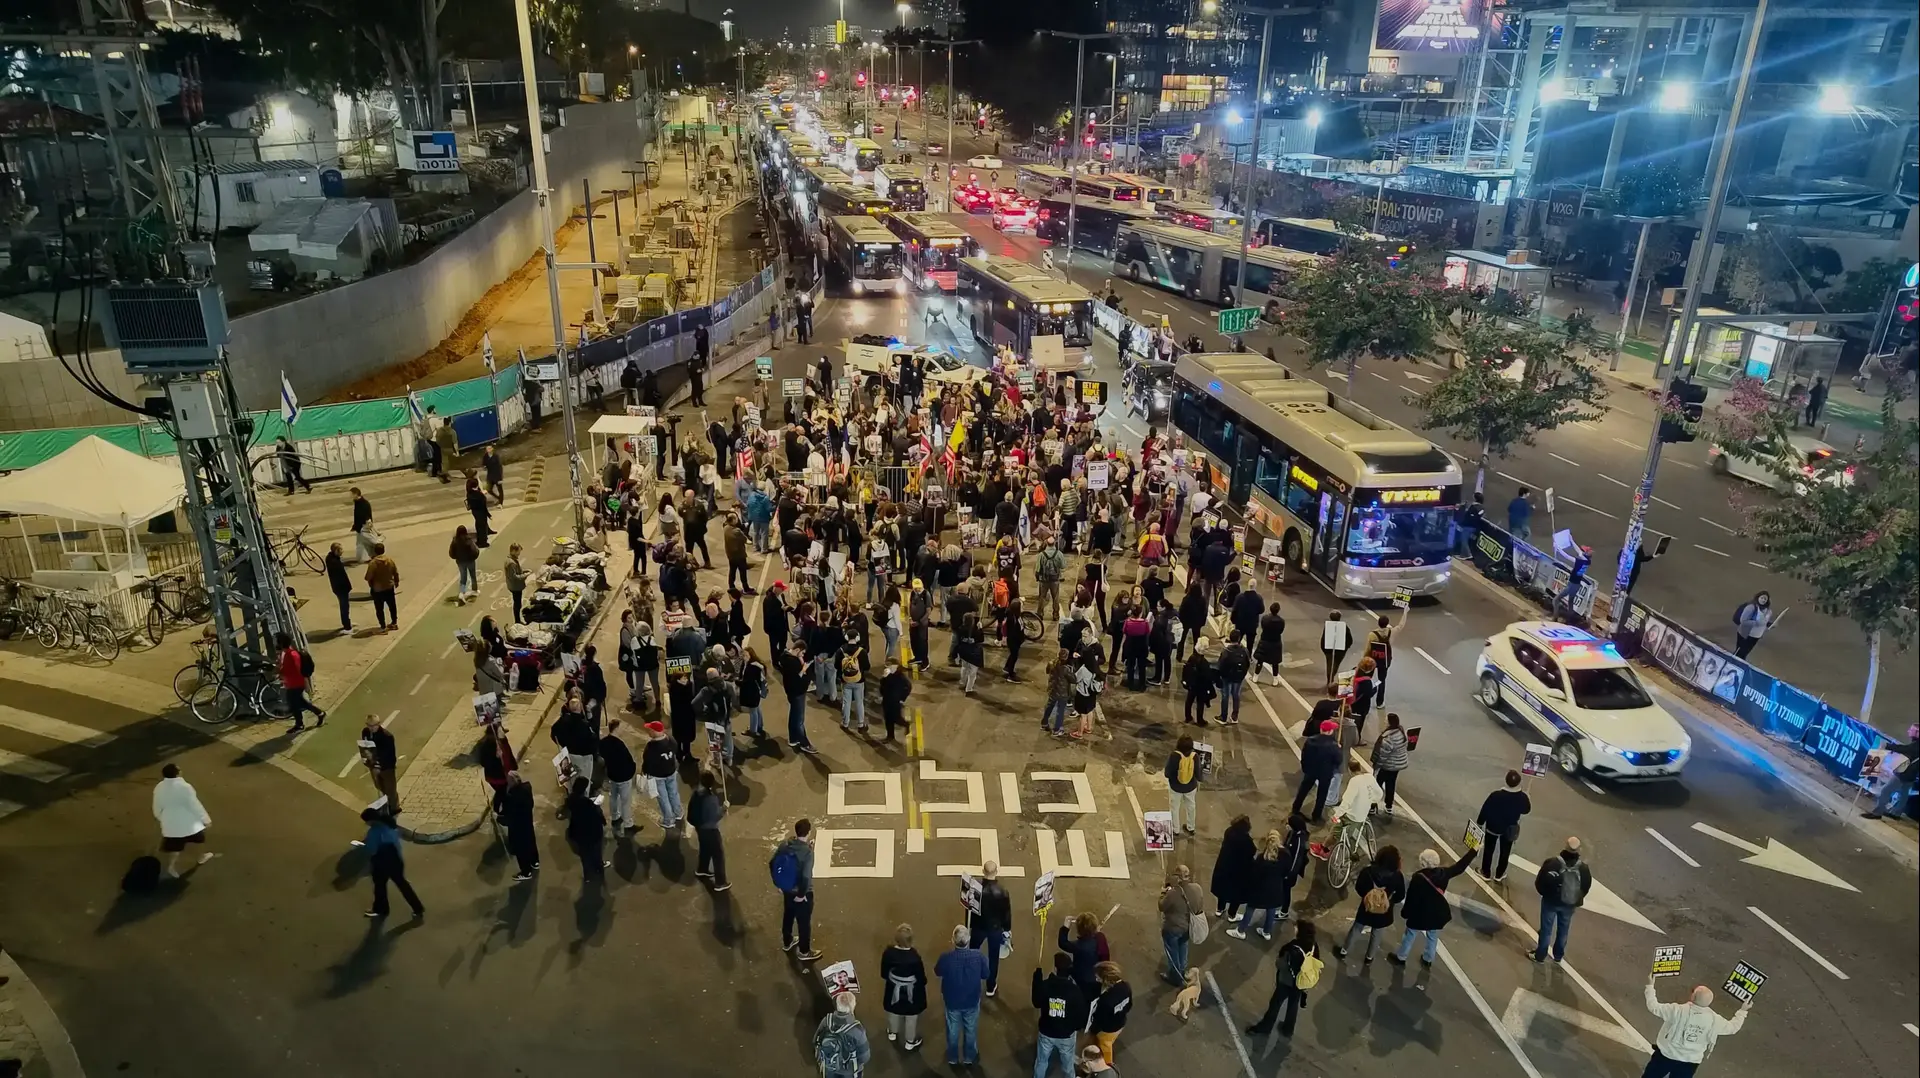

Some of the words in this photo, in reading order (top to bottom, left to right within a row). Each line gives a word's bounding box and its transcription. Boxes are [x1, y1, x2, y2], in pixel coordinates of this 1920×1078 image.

[422, 160, 460, 169] הנדסה
[1366, 199, 1399, 218] SPRAL
[1402, 204, 1444, 224] TOWER
[1821, 714, 1861, 751] מחזירים
[1818, 732, 1840, 757] ענבר
[1836, 746, 1857, 768] את
[827, 760, 1097, 814] כולם
[812, 828, 1130, 879] שבים
[1655, 947, 1684, 956] הימים
[1735, 963, 1749, 976] הם
[1746, 970, 1765, 986] למה
[1730, 971, 1758, 994] עדיין
